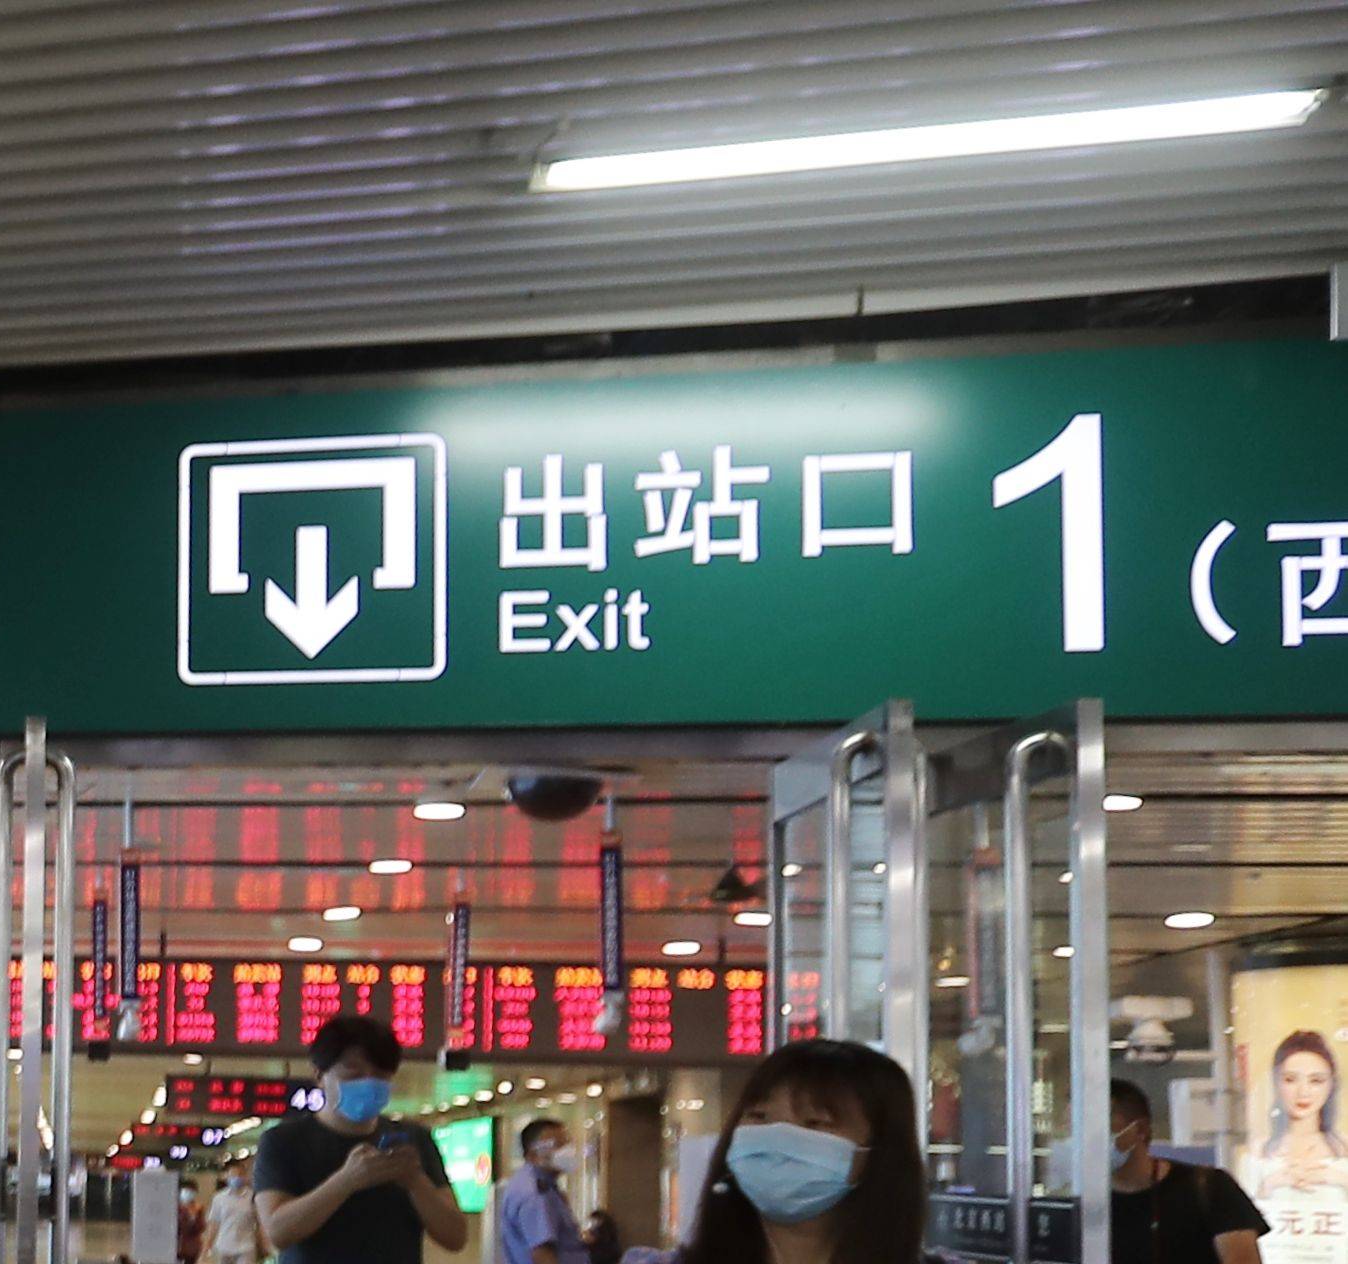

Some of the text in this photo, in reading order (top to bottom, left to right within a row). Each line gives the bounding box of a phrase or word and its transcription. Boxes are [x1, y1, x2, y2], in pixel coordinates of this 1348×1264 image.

[498, 445, 913, 571] 出站口
[993, 413, 1104, 652] 1
[499, 588, 650, 653] Exit
